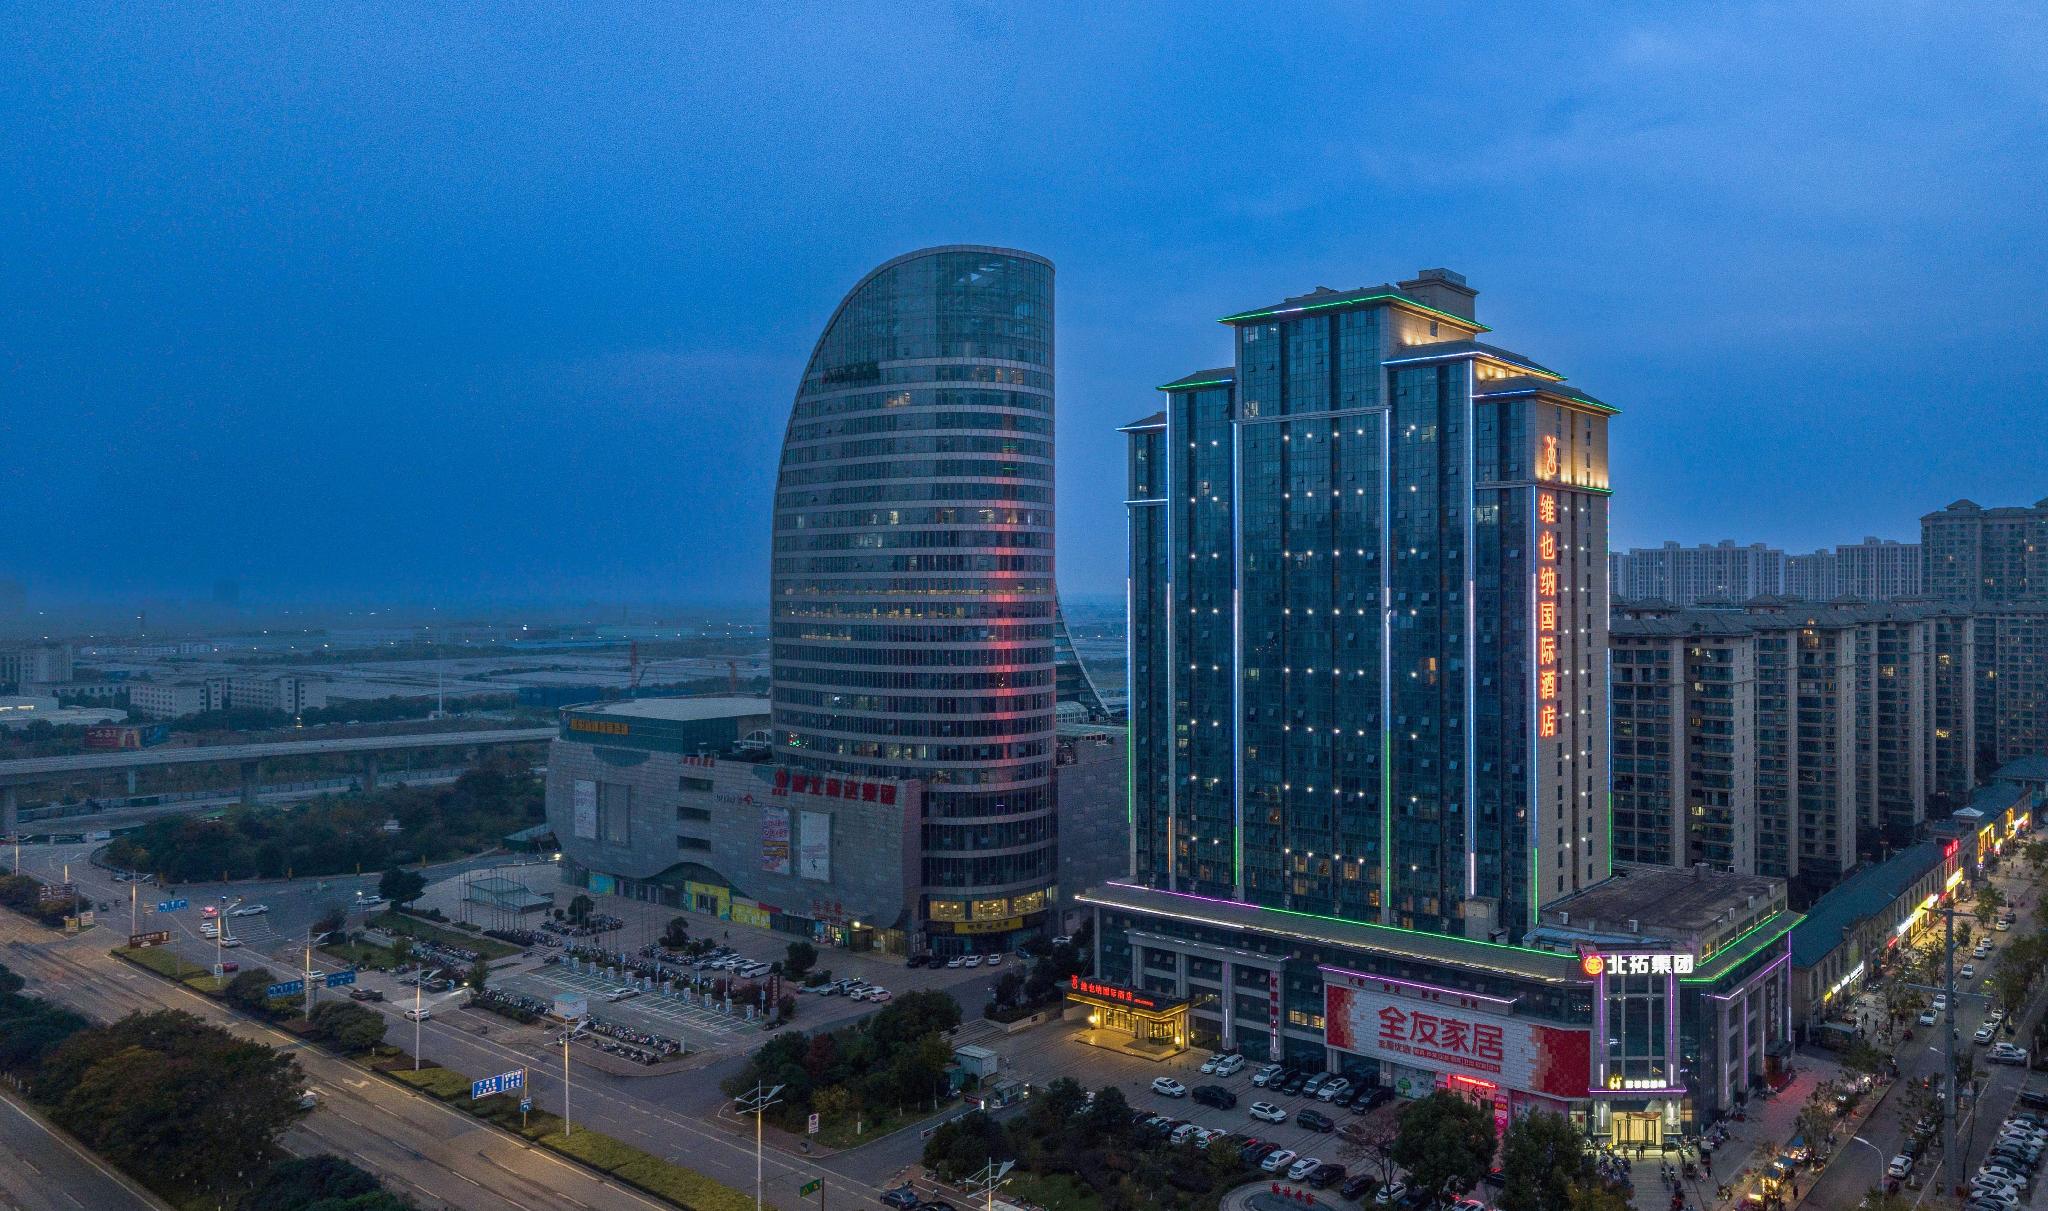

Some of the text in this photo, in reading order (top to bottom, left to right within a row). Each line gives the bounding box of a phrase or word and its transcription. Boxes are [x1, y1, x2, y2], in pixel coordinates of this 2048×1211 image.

[1540, 494, 1555, 737] 维也纳国际酒店
[1607, 955, 1694, 974] 北拓集团
[1378, 1006, 1504, 1061] 全友家居
